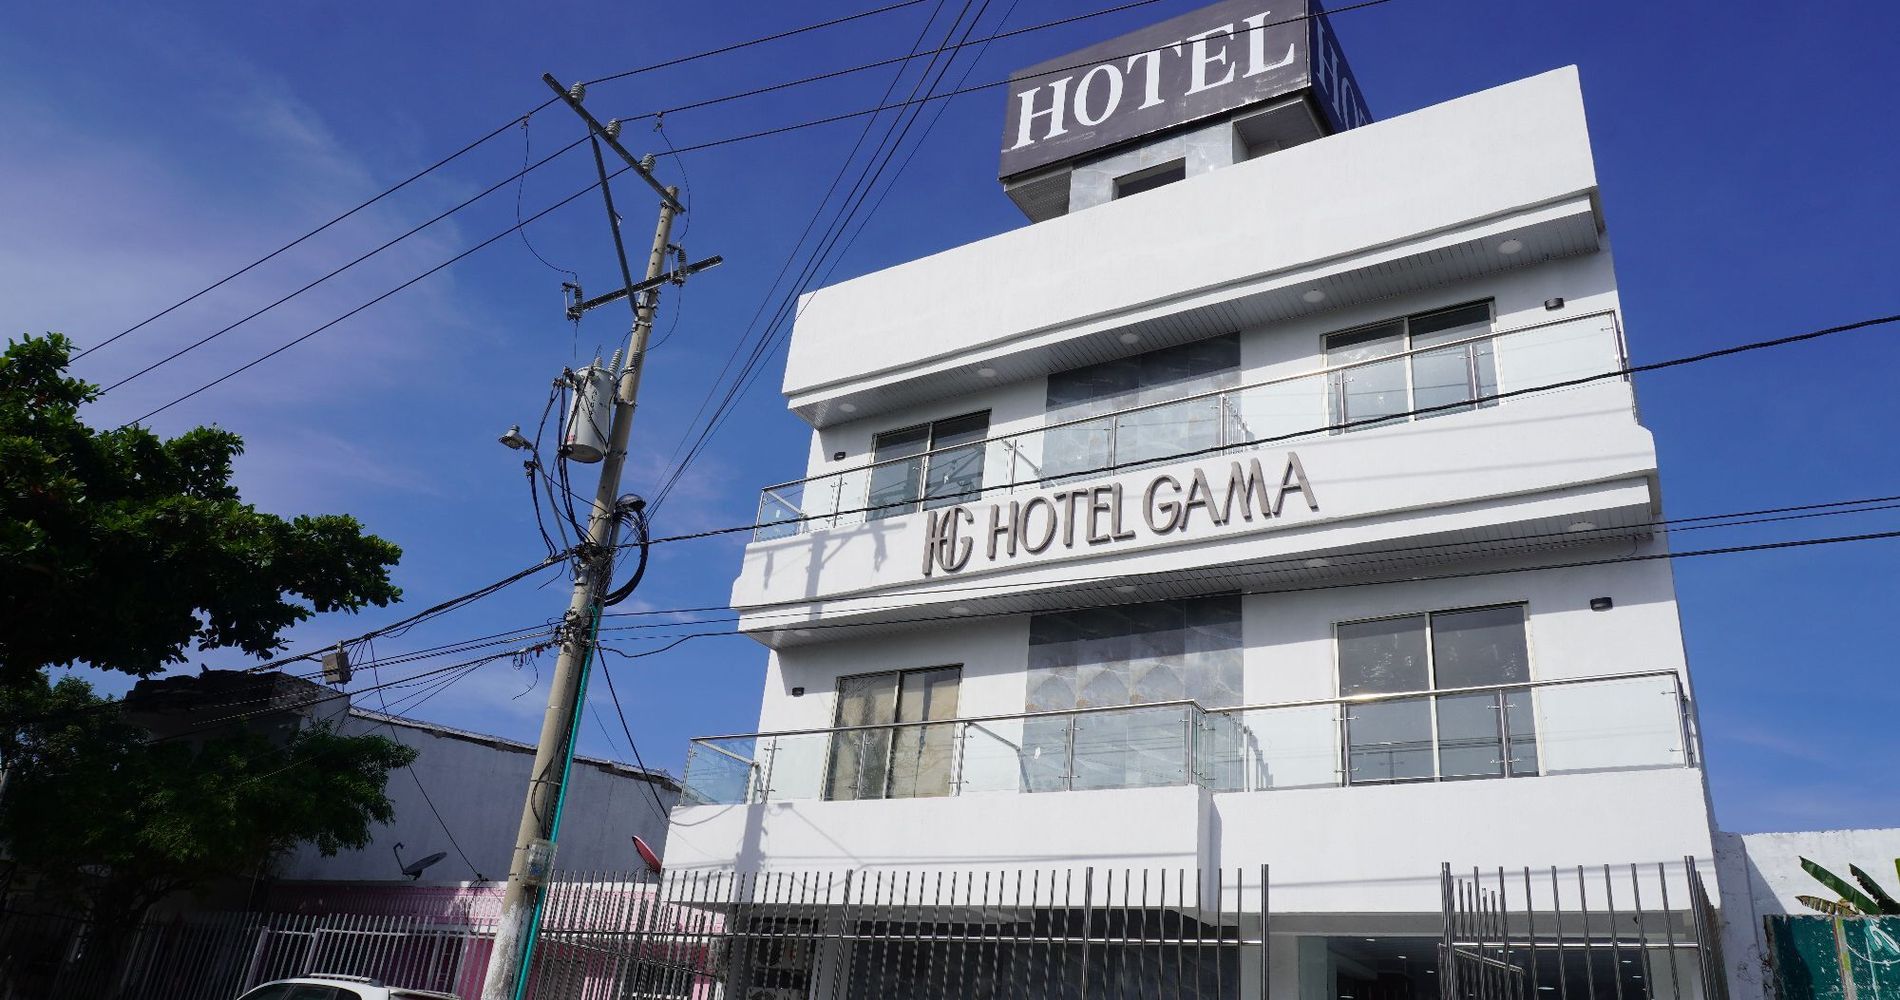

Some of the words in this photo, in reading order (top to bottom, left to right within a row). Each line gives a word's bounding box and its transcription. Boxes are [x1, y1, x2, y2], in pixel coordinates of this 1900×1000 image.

[1011, 11, 1294, 149] HOTEL
[1315, 12, 1368, 130] HO
[986, 482, 1135, 560] HOTEL
[1142, 451, 1319, 534] GAMA
